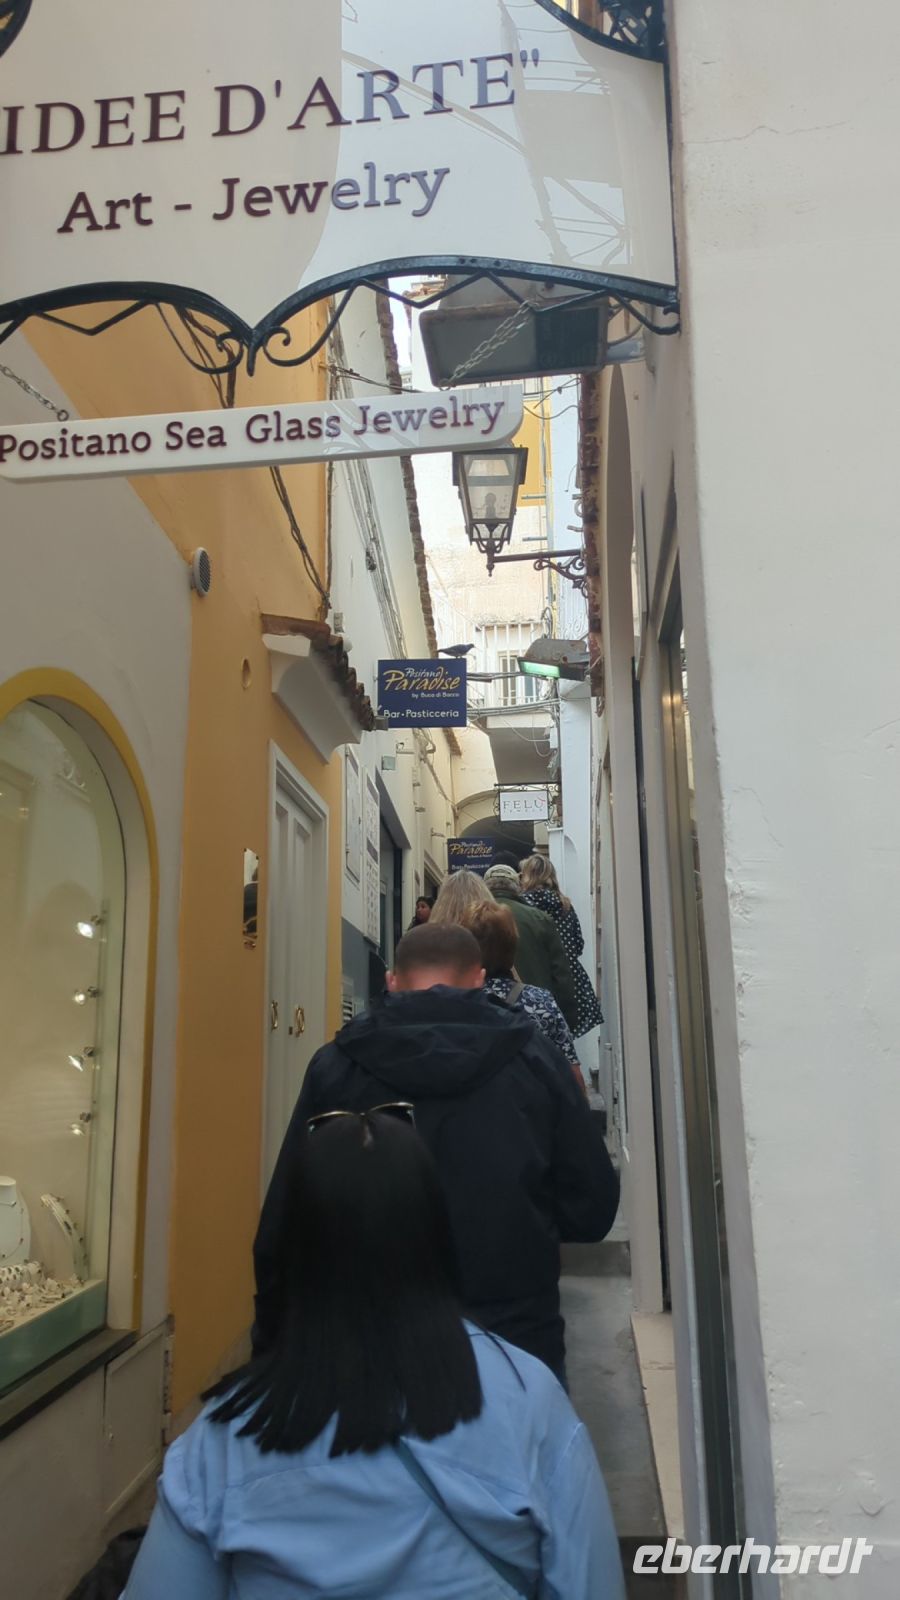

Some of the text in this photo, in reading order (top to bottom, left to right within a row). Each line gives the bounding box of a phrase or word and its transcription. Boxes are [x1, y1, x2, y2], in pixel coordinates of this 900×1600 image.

[0, 48, 540, 156] IDEE D'ARTE"
[57, 191, 153, 233] Art
[212, 161, 450, 220] Jewelry
[0, 396, 505, 462] Positano Sea Glass Jewelry
[383, 669, 461, 691] Paradise
[405, 666, 444, 678] Positano
